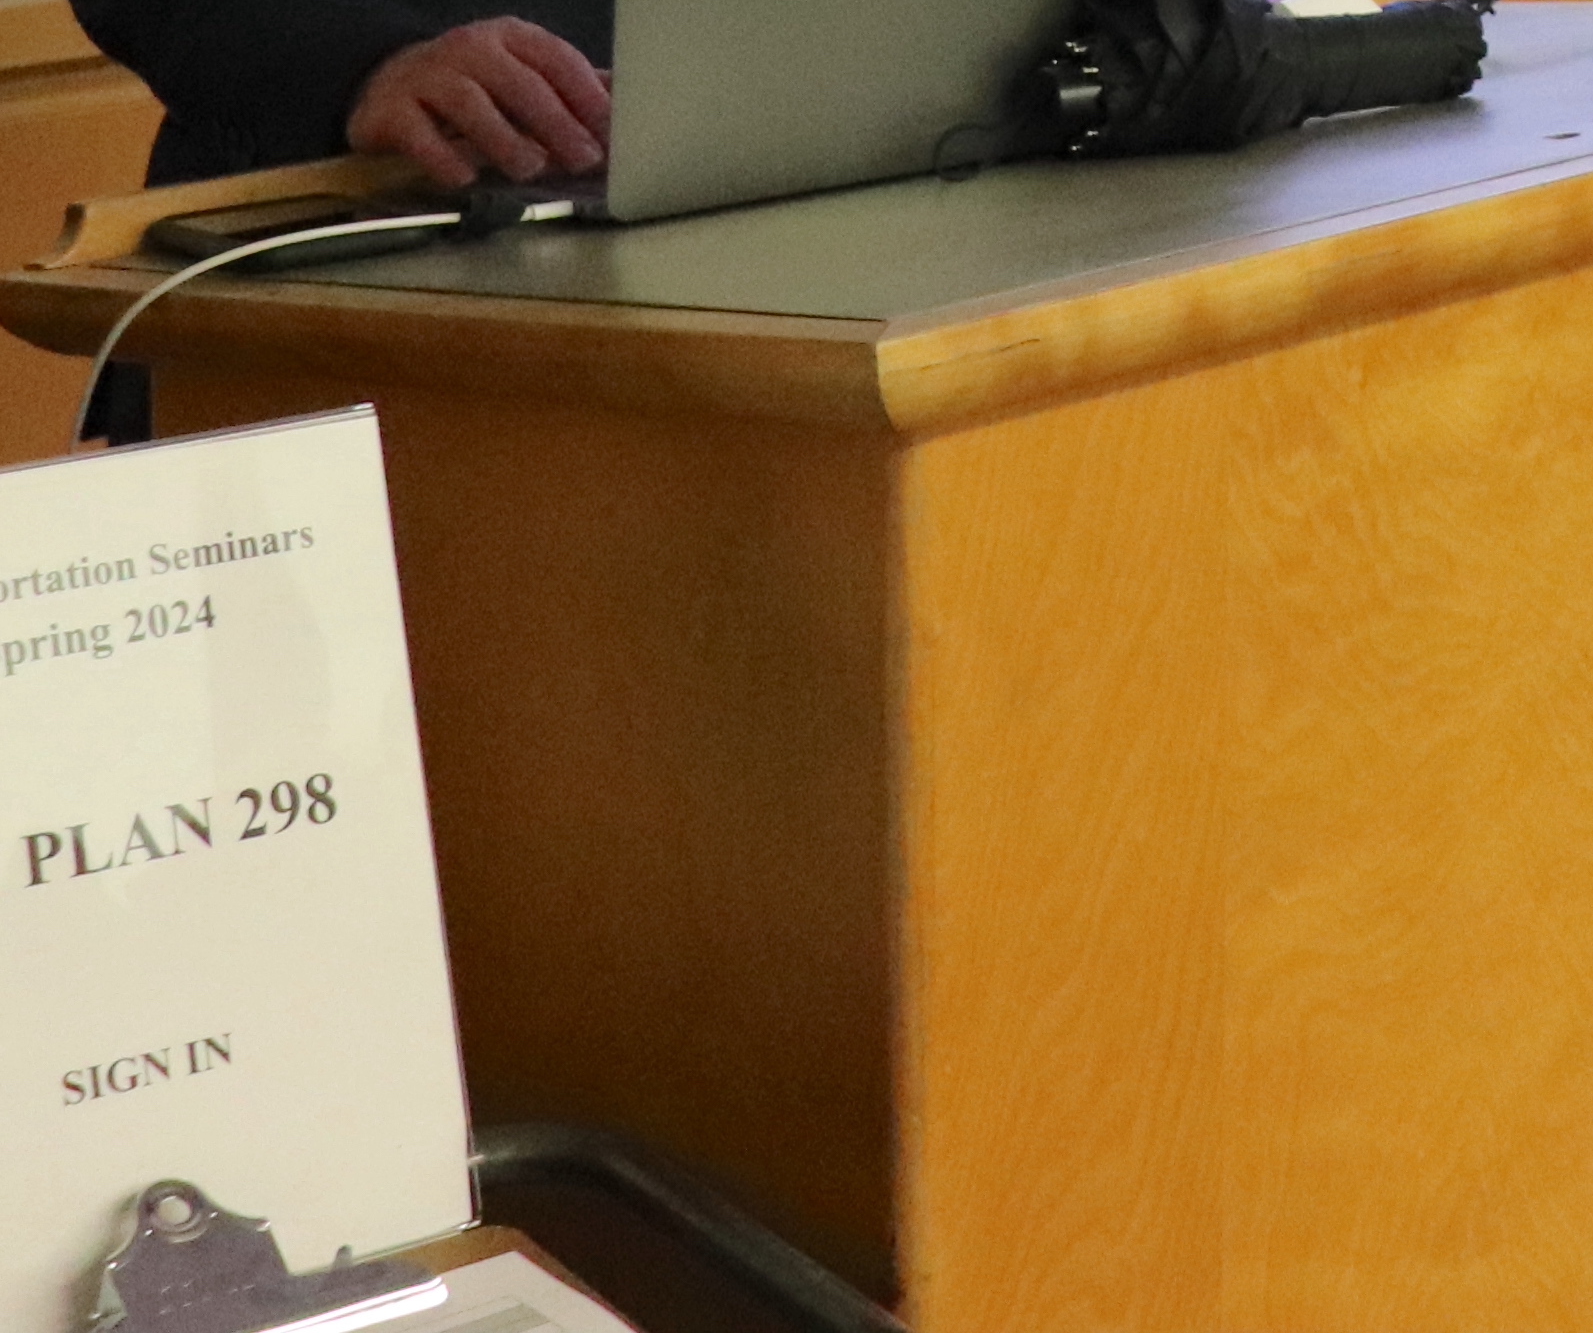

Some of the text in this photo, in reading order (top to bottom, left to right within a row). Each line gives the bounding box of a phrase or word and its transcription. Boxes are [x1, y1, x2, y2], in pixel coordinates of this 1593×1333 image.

[0, 525, 316, 604] ortation Seminars
[1, 594, 218, 677] pring 2024
[19, 772, 339, 889] PLAN 298
[61, 1032, 233, 1107] SIGN IN
